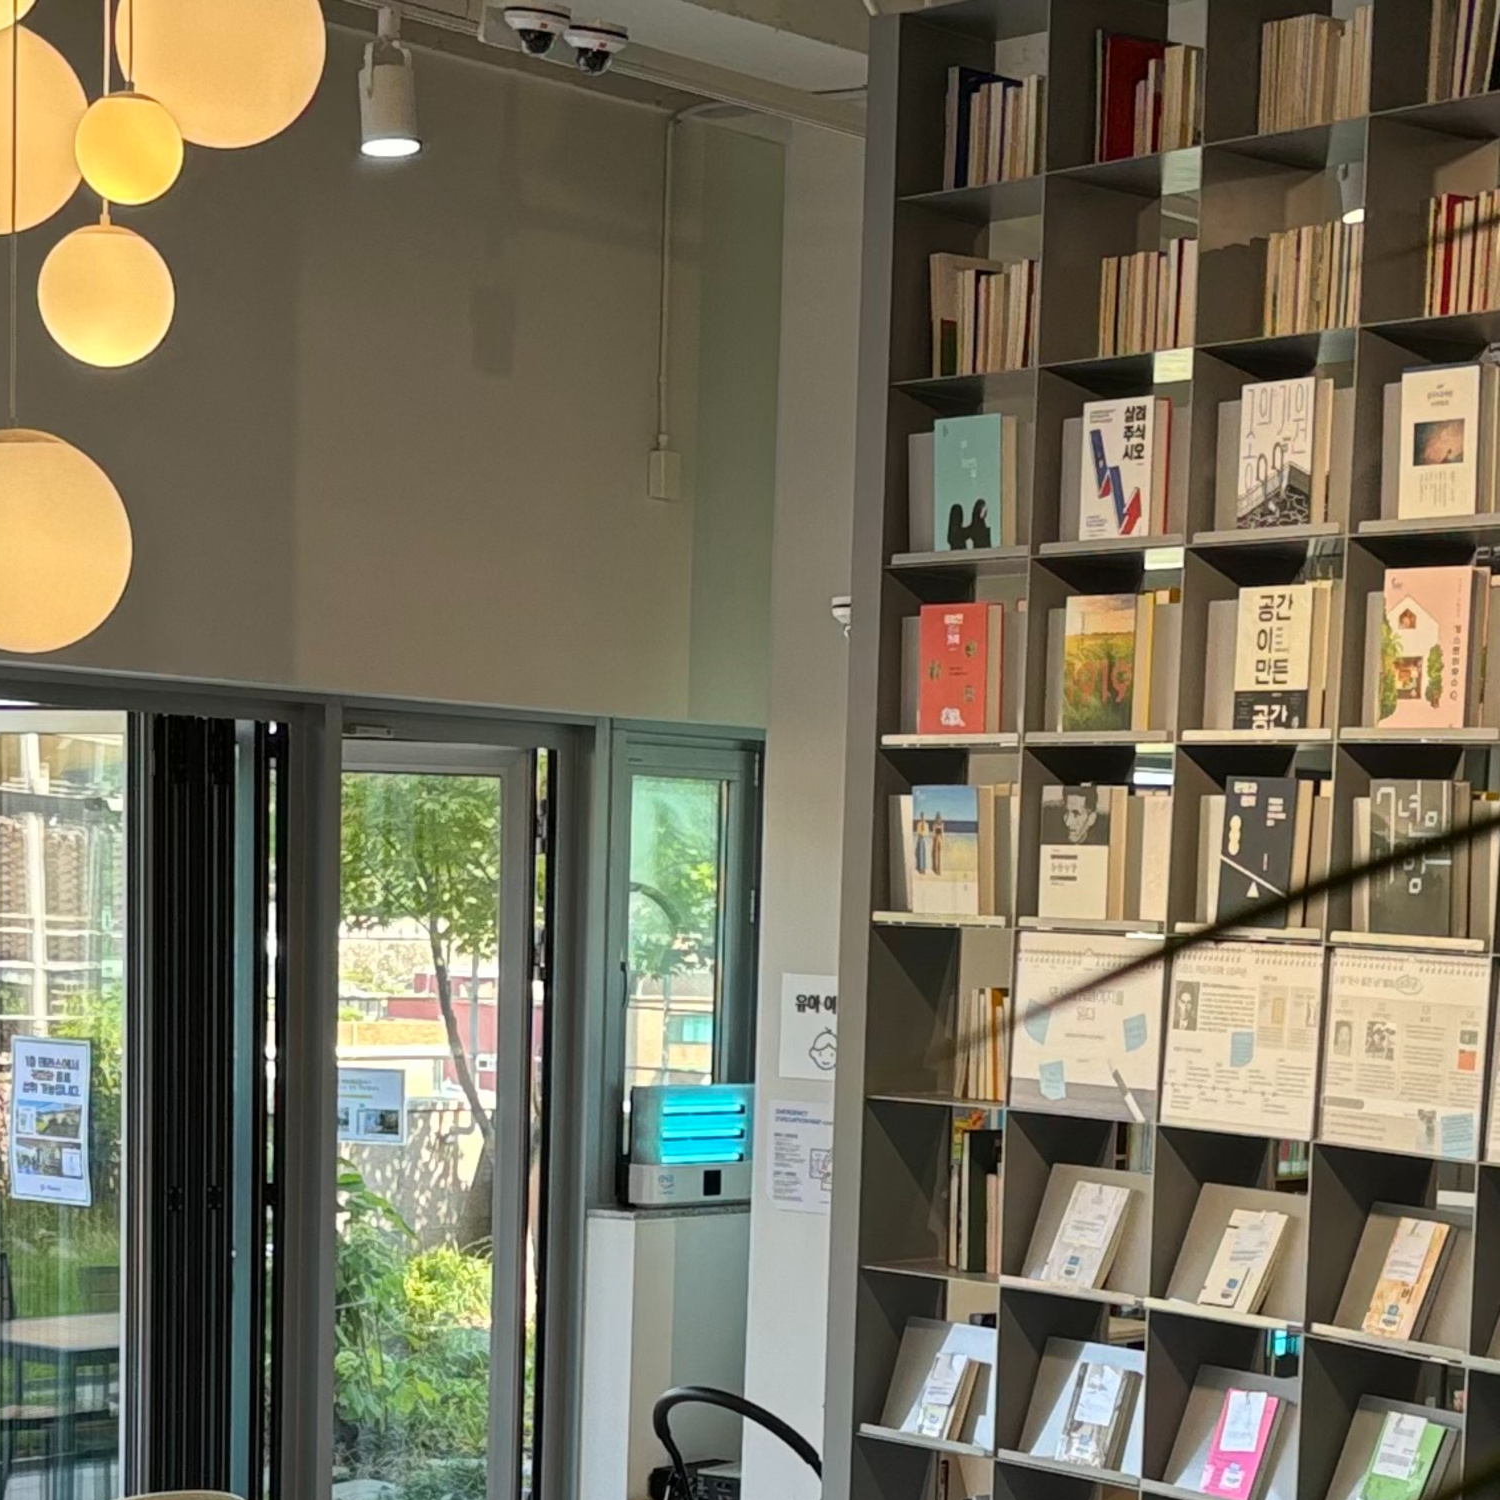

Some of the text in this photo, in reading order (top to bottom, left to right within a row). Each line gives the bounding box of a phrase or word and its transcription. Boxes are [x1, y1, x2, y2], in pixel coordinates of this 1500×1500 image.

[1123, 443, 1145, 461] 시오
[1258, 593, 1294, 622] 공간
[1256, 626, 1273, 654] 이
[1255, 658, 1289, 685] 만든
[795, 994, 820, 1014] 유아
